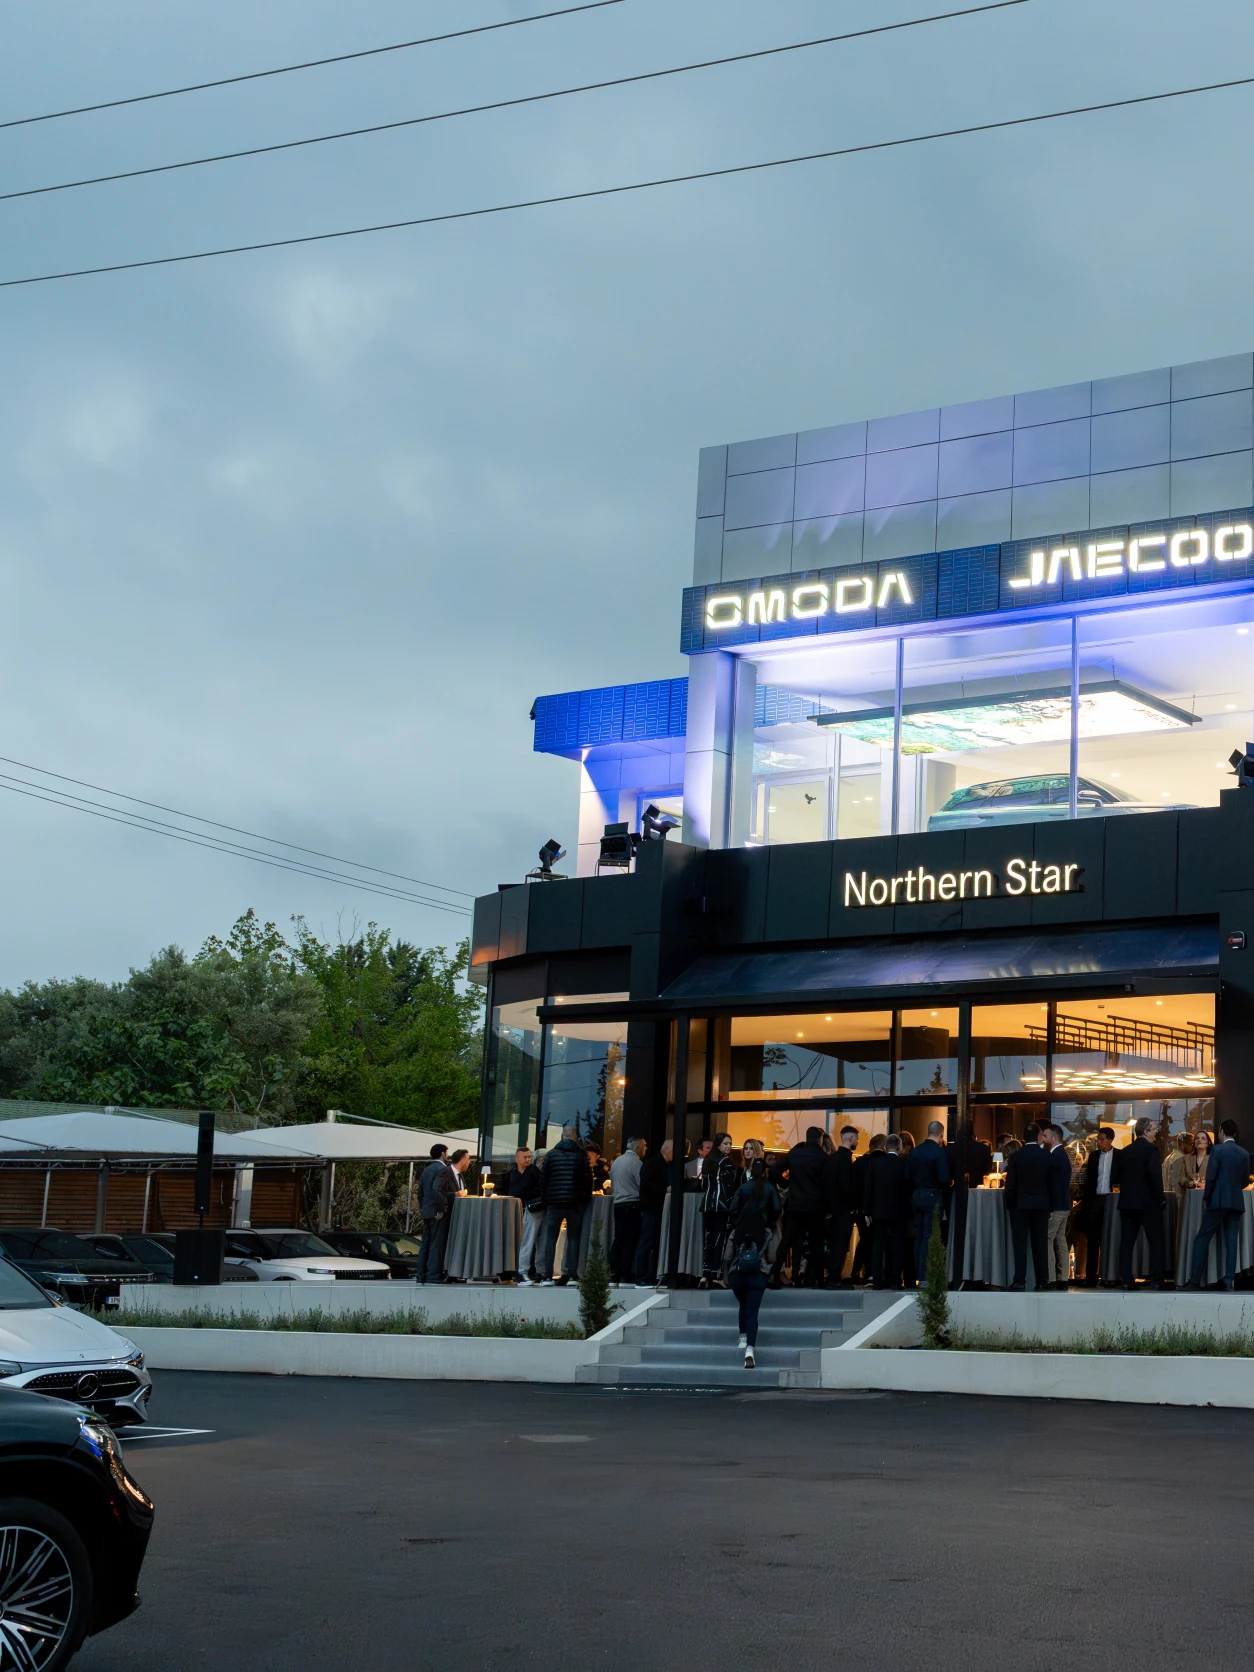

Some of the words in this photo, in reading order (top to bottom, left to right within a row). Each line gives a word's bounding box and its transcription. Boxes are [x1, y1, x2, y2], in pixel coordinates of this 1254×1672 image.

[1008, 523, 1253, 588] JAECOO
[706, 572, 913, 630] OMODA
[844, 866, 993, 907] Northern
[1005, 858, 1078, 895] Star
